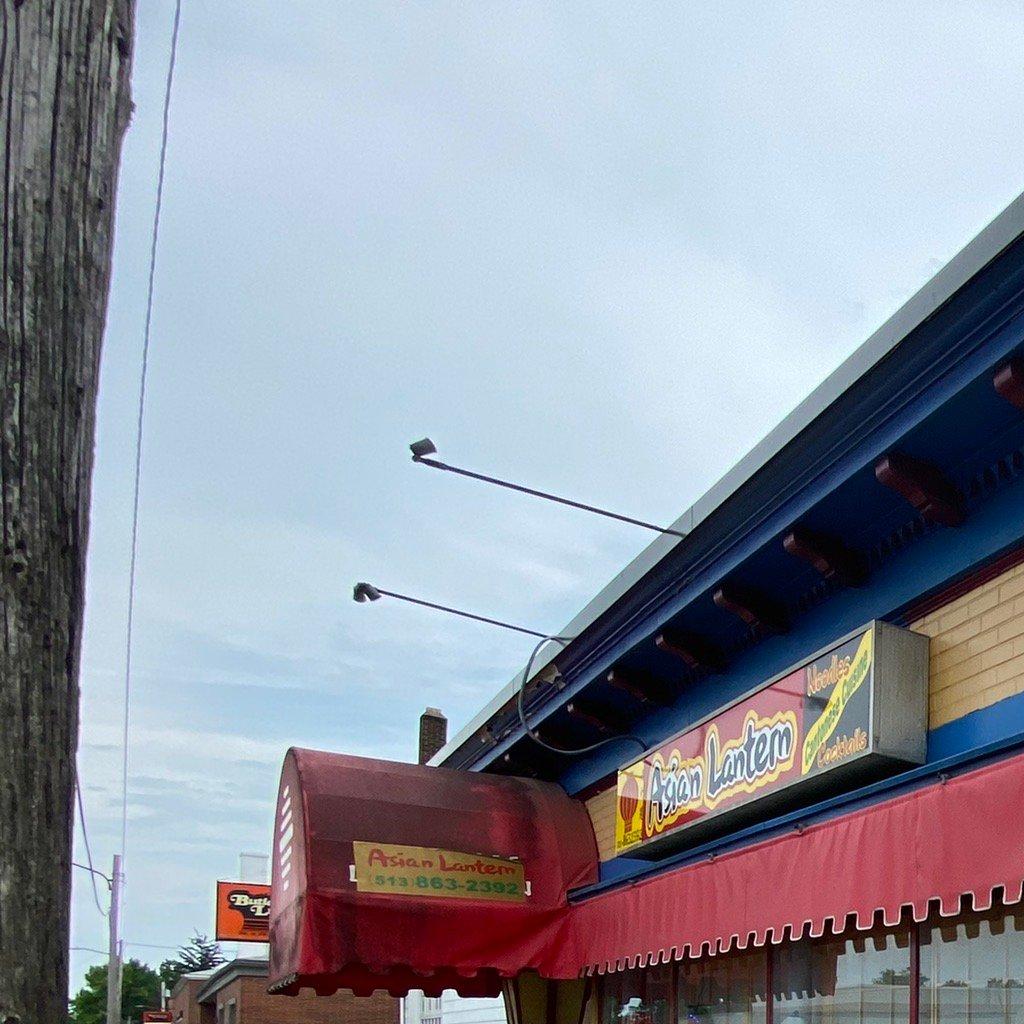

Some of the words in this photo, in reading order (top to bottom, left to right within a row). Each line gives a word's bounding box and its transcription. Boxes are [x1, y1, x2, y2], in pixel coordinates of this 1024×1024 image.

[807, 655, 851, 697] Noodles
[645, 756, 703, 831] Asian
[706, 719, 794, 799] Lantern
[368, 848, 434, 868] Asian
[438, 854, 516, 876] Lantern
